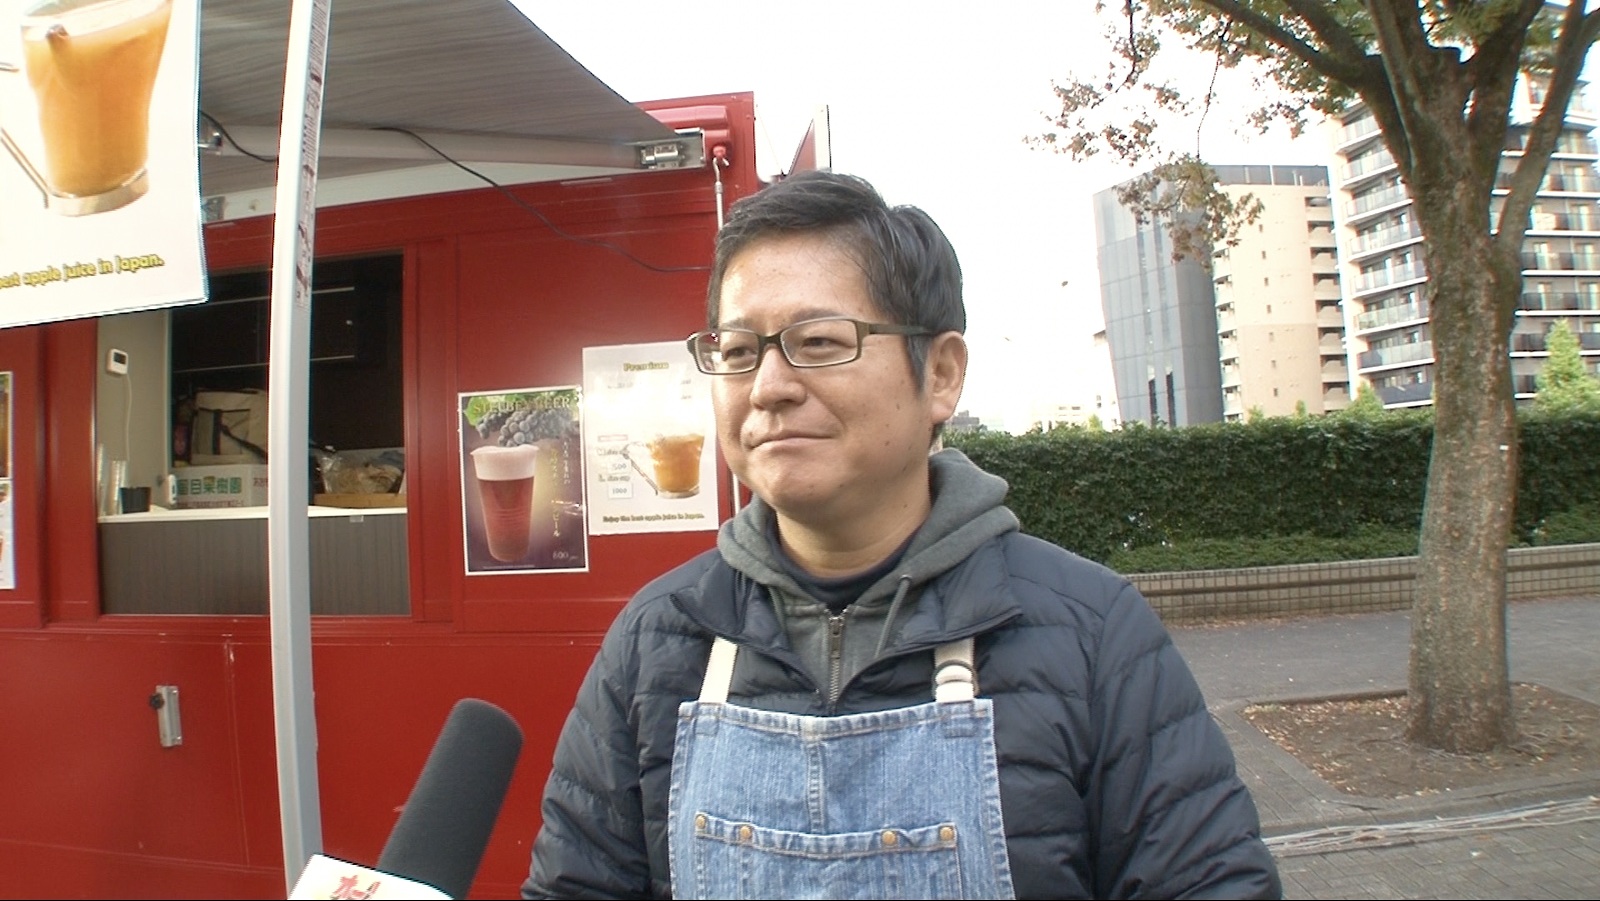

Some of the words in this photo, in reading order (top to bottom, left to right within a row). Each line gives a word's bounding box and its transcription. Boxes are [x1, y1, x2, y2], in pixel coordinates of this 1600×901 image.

[0, 271, 21, 289] est
[23, 266, 61, 287] apple
[62, 260, 97, 282] juice
[97, 258, 113, 274] in
[114, 254, 165, 274] Japan.
